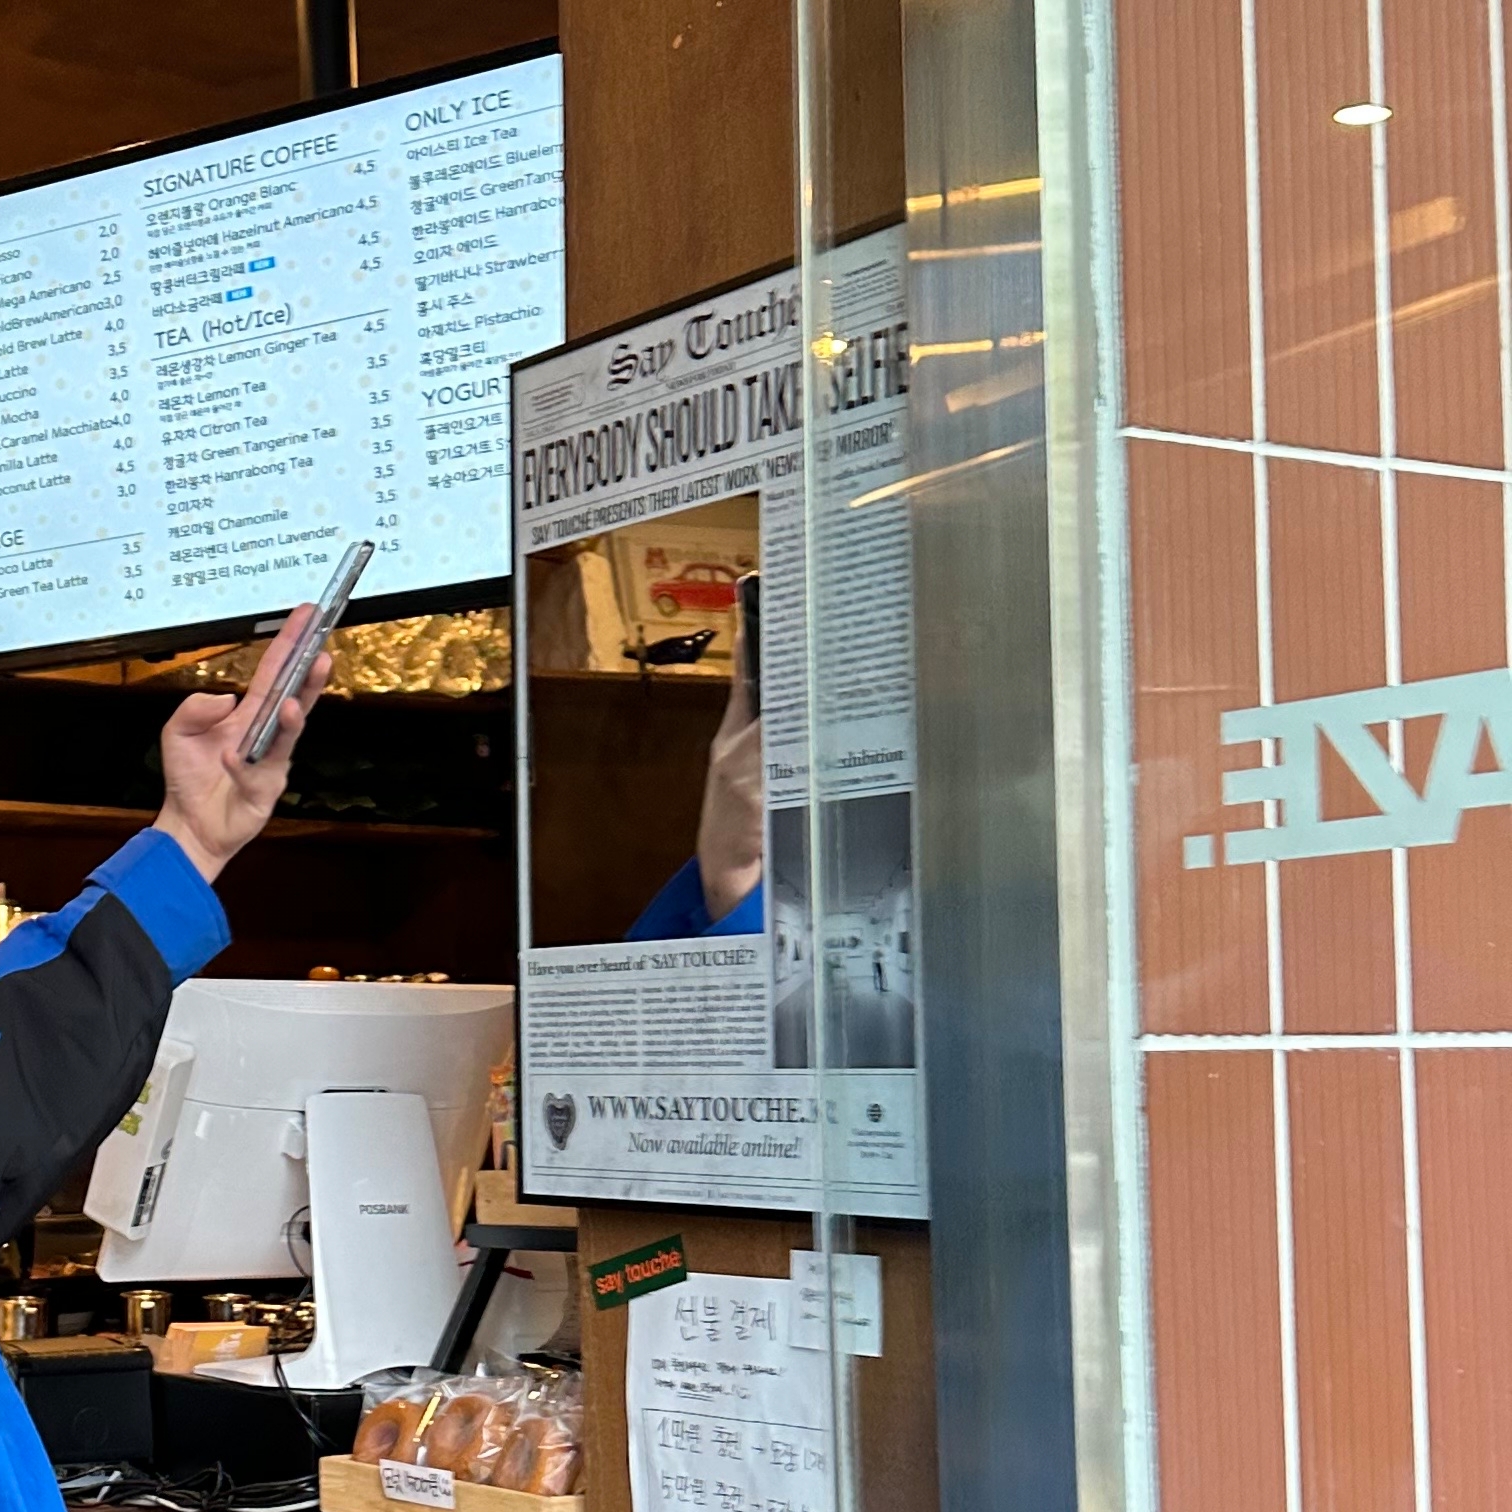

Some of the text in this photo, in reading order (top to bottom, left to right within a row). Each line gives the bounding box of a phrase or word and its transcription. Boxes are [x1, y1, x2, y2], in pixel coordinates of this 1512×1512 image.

[405, 89, 512, 132] ONLY ICE
[406, 127, 519, 160] 아이스티 Ice Tea
[143, 133, 340, 198] SIGNATURE COFFEE
[208, 190, 257, 213] Orange
[259, 180, 299, 199] Blanc
[221, 219, 282, 243] Hazelnut
[282, 203, 355, 229] Americano
[28, 278, 92, 302] Americano
[154, 302, 294, 349] TEA (Hot/Ice)
[474, 305, 544, 329] Pistachio
[17, 336, 48, 353] Brew
[50, 329, 84, 345] Latte
[218, 347, 262, 366] Lemon
[264, 337, 310, 356] Ginger
[312, 329, 338, 345] Tea
[607, 339, 676, 391] Say
[197, 387, 240, 404] Lemon
[242, 380, 267, 395] Tea
[0, 409, 39, 427] Mocha
[199, 420, 241, 438] Citron
[243, 414, 268, 429] Tea
[1, 431, 49, 449] Caramel
[51, 419, 113, 438] Macchiato
[201, 445, 239, 462] Green
[242, 434, 309, 453] Tangerine
[312, 427, 337, 441] Tea
[522, 412, 643, 510] EVERYBODY
[645, 384, 738, 472] SHOULD
[743, 361, 804, 443] TAKE
[26, 452, 58, 468] Latte
[215, 461, 287, 484] Hanrabong
[289, 456, 314, 470] Tea
[39, 474, 72, 490] Latte
[531, 523, 551, 546] SAY
[594, 498, 645, 530] PRESENTS
[648, 486, 679, 512] THEIR
[682, 473, 721, 503] LATEST
[723, 463, 760, 493] WORK
[217, 509, 289, 530] Chamomile
[232, 535, 275, 553] Lemon
[277, 525, 339, 545] Lavender
[21, 556, 54, 572] Latte
[233, 561, 270, 578] Royal
[273, 556, 301, 571] Milk
[304, 551, 328, 566] Tea
[32, 580, 54, 594] Tea
[56, 574, 89, 590] Latte
[528, 960, 555, 976] Have
[555, 963, 575, 979] you
[576, 962, 599, 973] ever
[600, 957, 632, 972] heard
[633, 954, 648, 971] of
[627, 1132, 802, 1159] Now available online!
[595, 1272, 624, 1295] say
[675, 1295, 721, 1342] 선불
